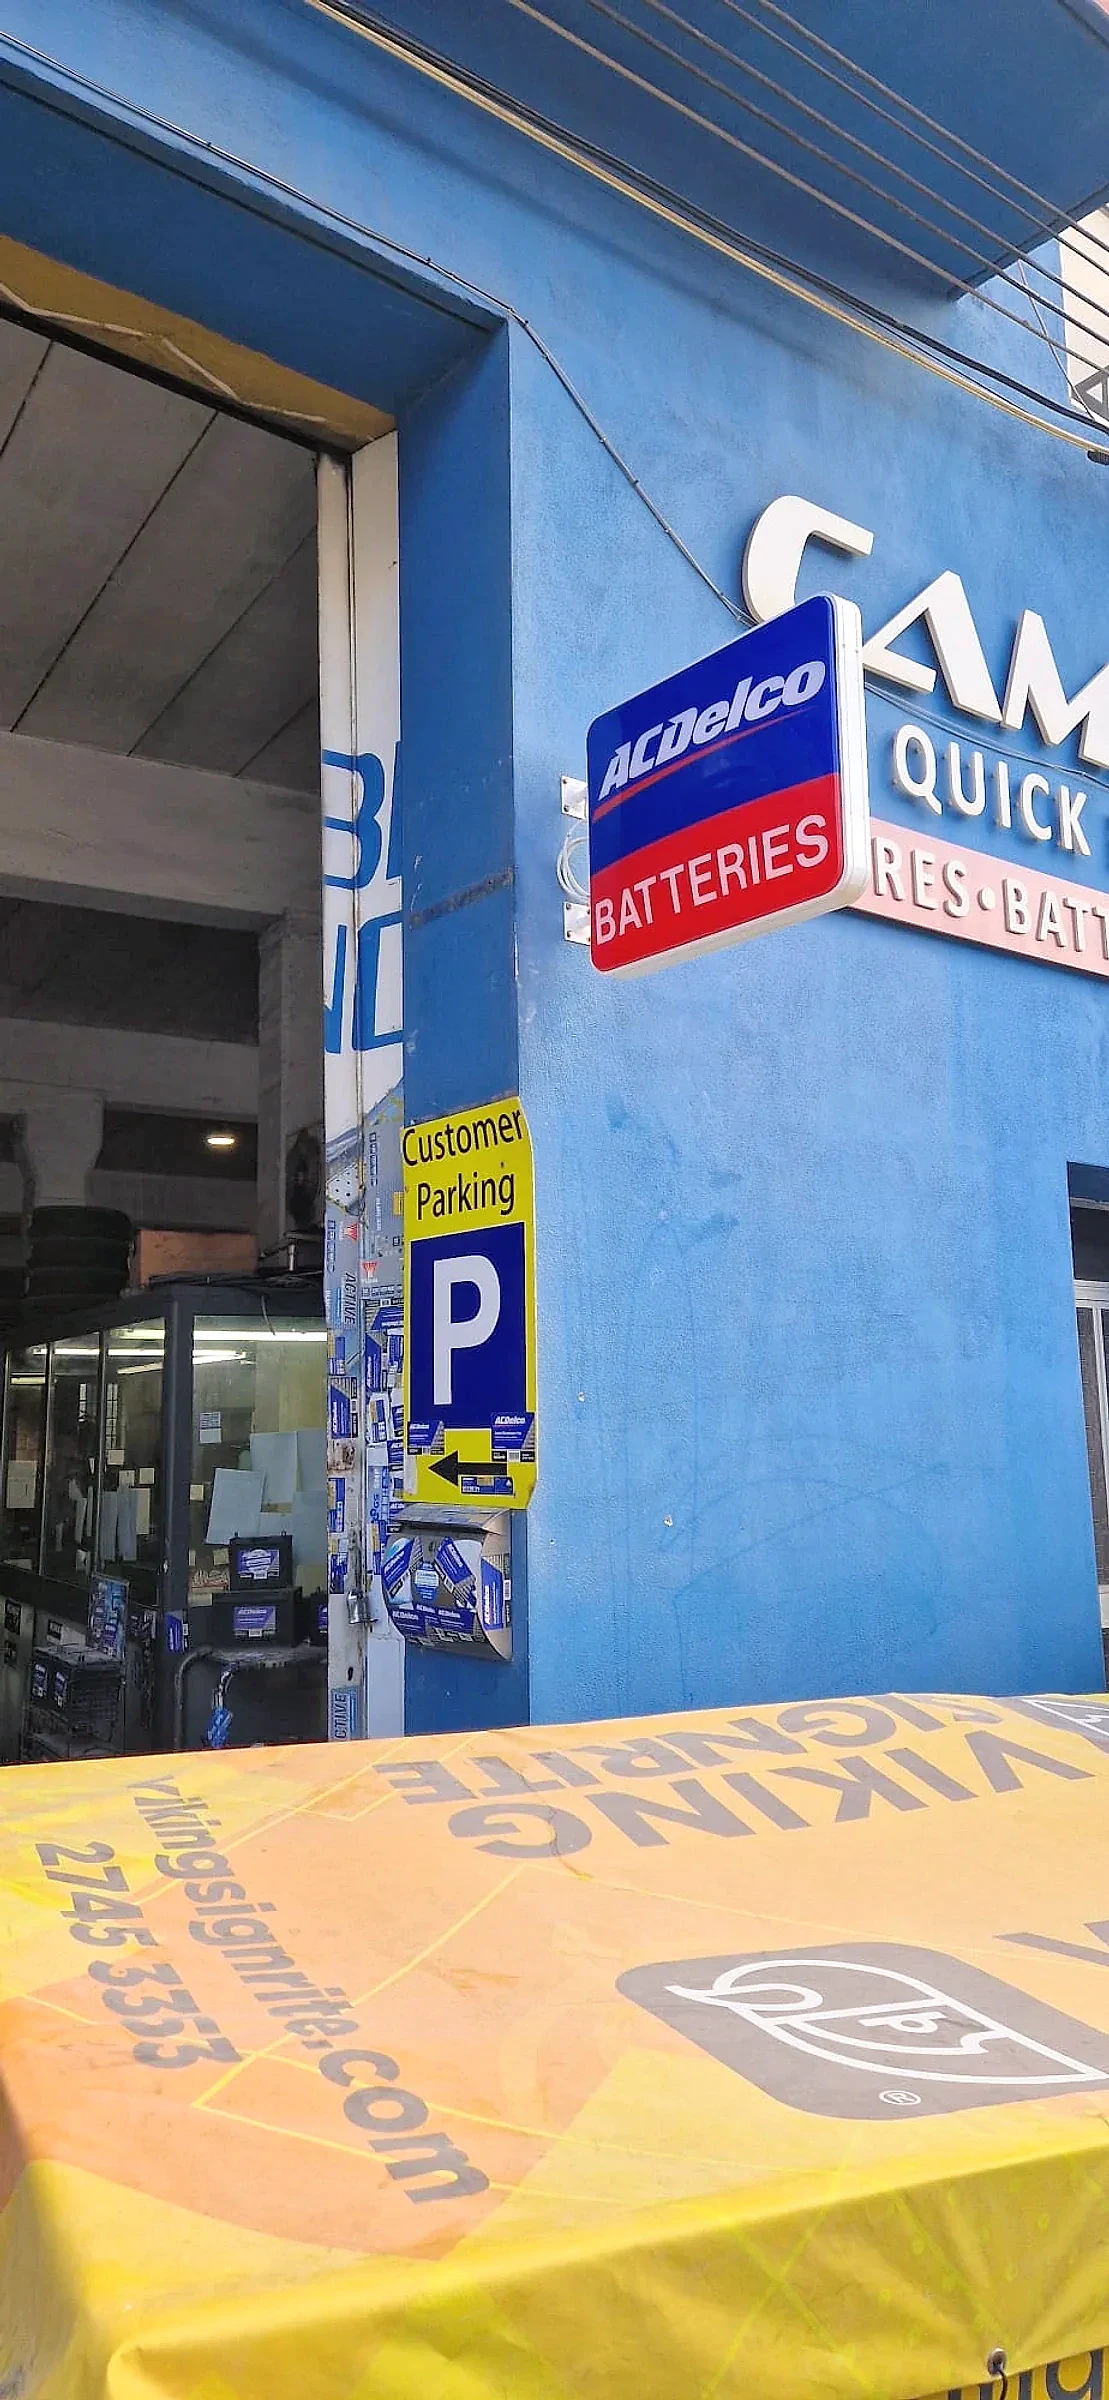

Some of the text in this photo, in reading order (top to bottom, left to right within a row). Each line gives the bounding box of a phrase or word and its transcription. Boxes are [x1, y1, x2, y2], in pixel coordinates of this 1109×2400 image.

[597, 659, 827, 802] ACDelco
[892, 723, 1092, 857] QUICK
[595, 814, 830, 945] BATTERIES
[402, 1109, 524, 1167] Customer
[416, 1171, 515, 1221] Parking
[344, 1272, 358, 1326] ACTIVE
[433, 1254, 501, 1405] P
[447, 1729, 1097, 1859] VIKING
[34, 1841, 244, 2070] 2745 3353
[128, 1776, 491, 2204] vikingsignrite.com
